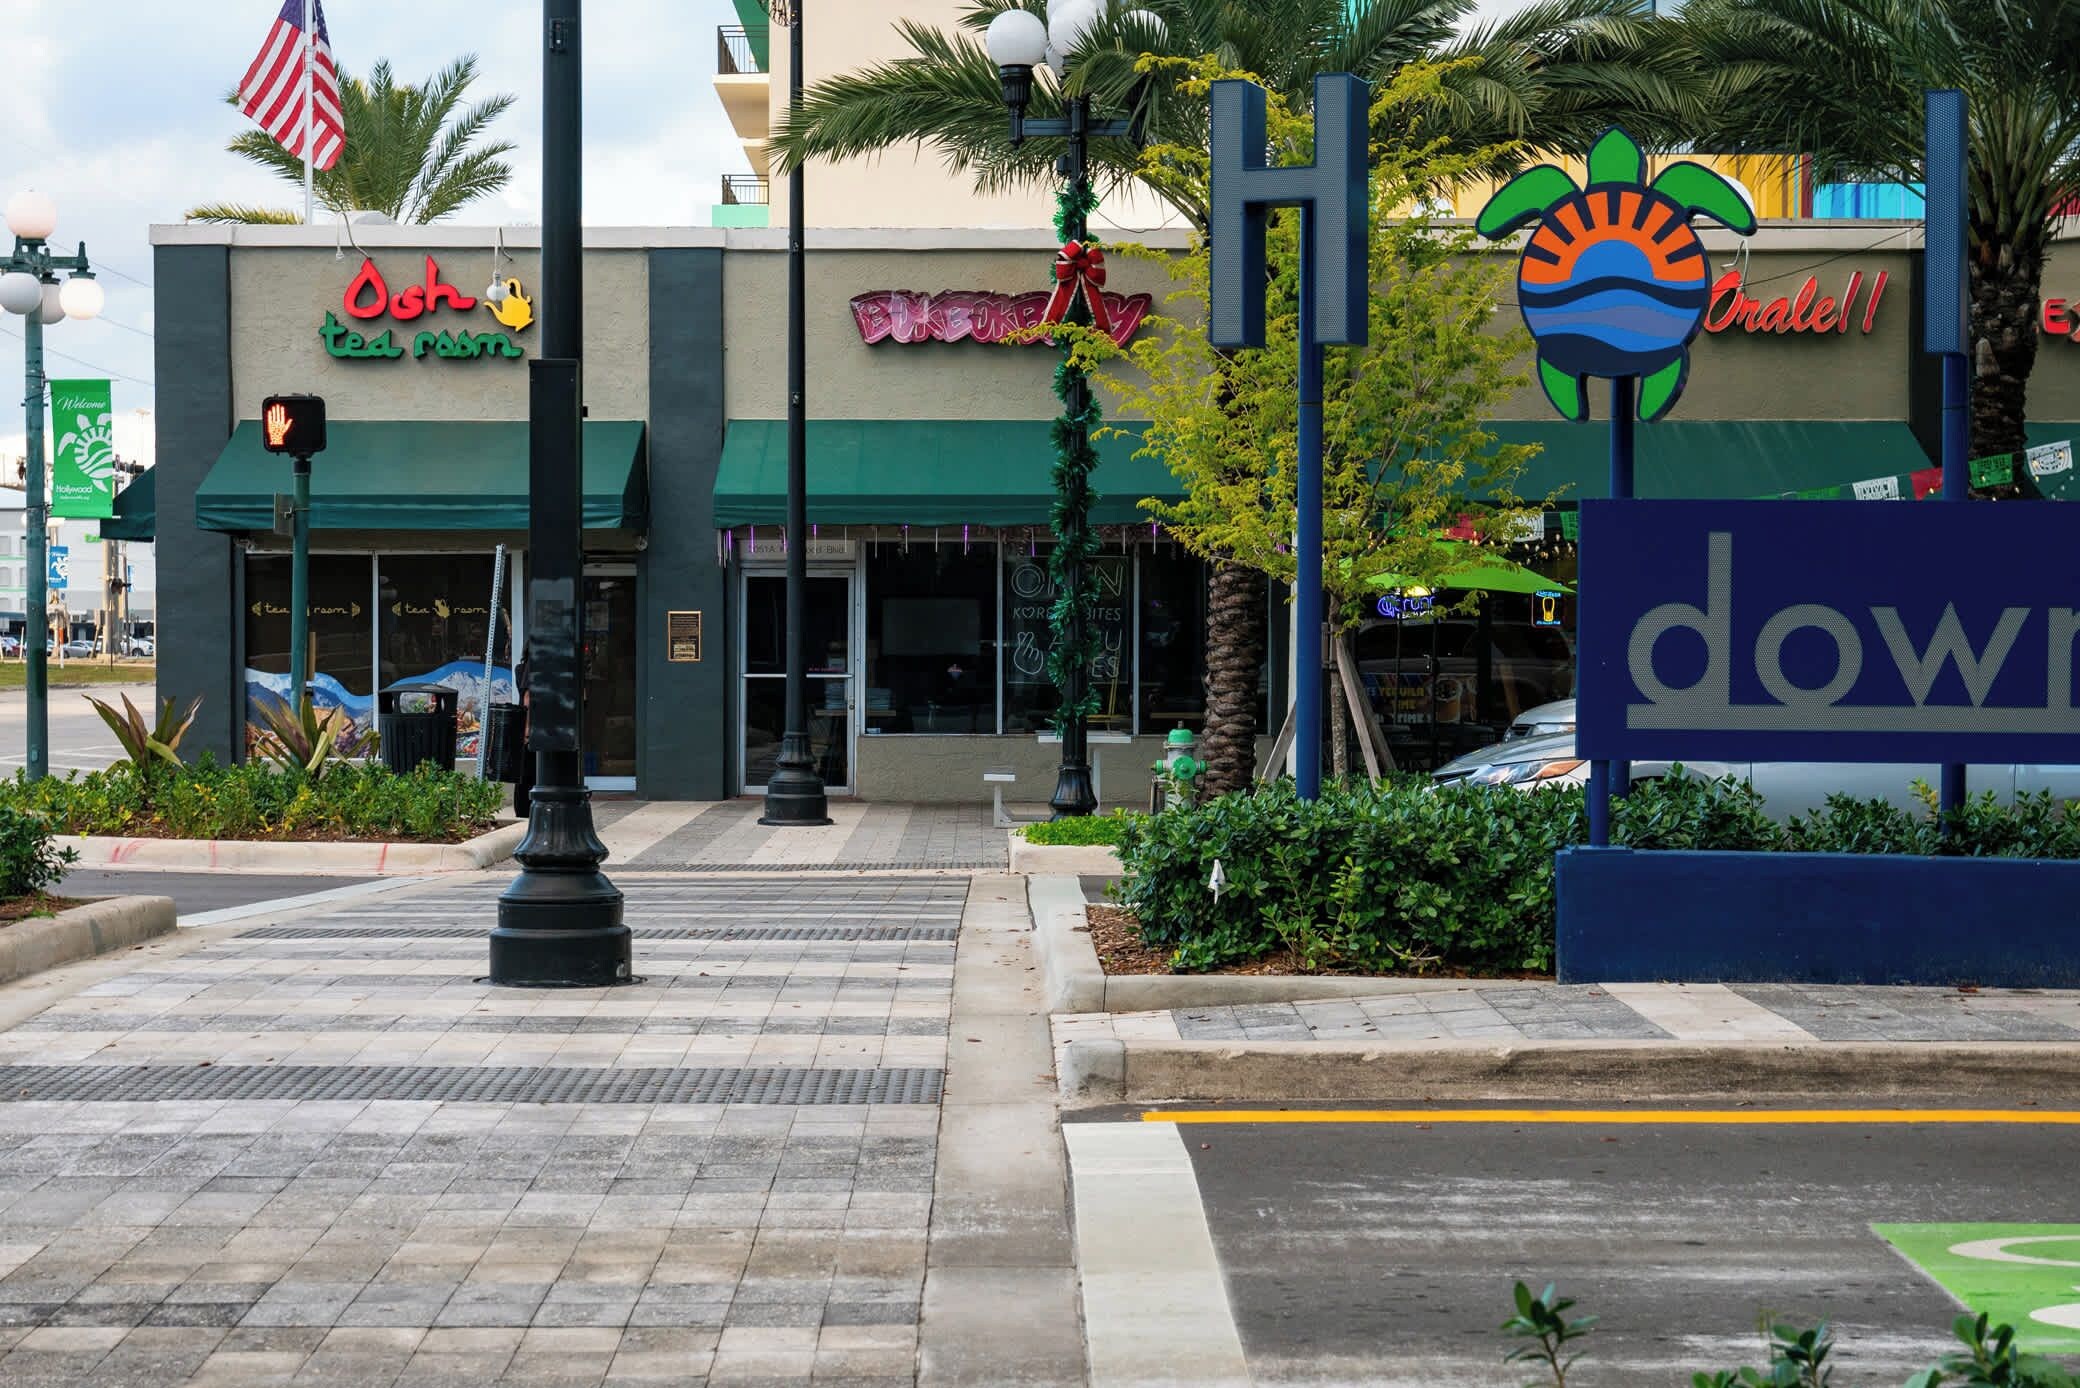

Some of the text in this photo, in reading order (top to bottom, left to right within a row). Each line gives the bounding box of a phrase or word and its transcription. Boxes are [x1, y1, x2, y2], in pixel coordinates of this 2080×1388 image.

[344, 255, 478, 320] Osh
[850, 289, 1152, 350] BOKBOKBY
[318, 310, 525, 359] tea room
[57, 395, 106, 410] Welcome
[56, 484, 93, 495] Hollywood
[264, 602, 349, 615] tea room
[405, 602, 488, 615] tea room
